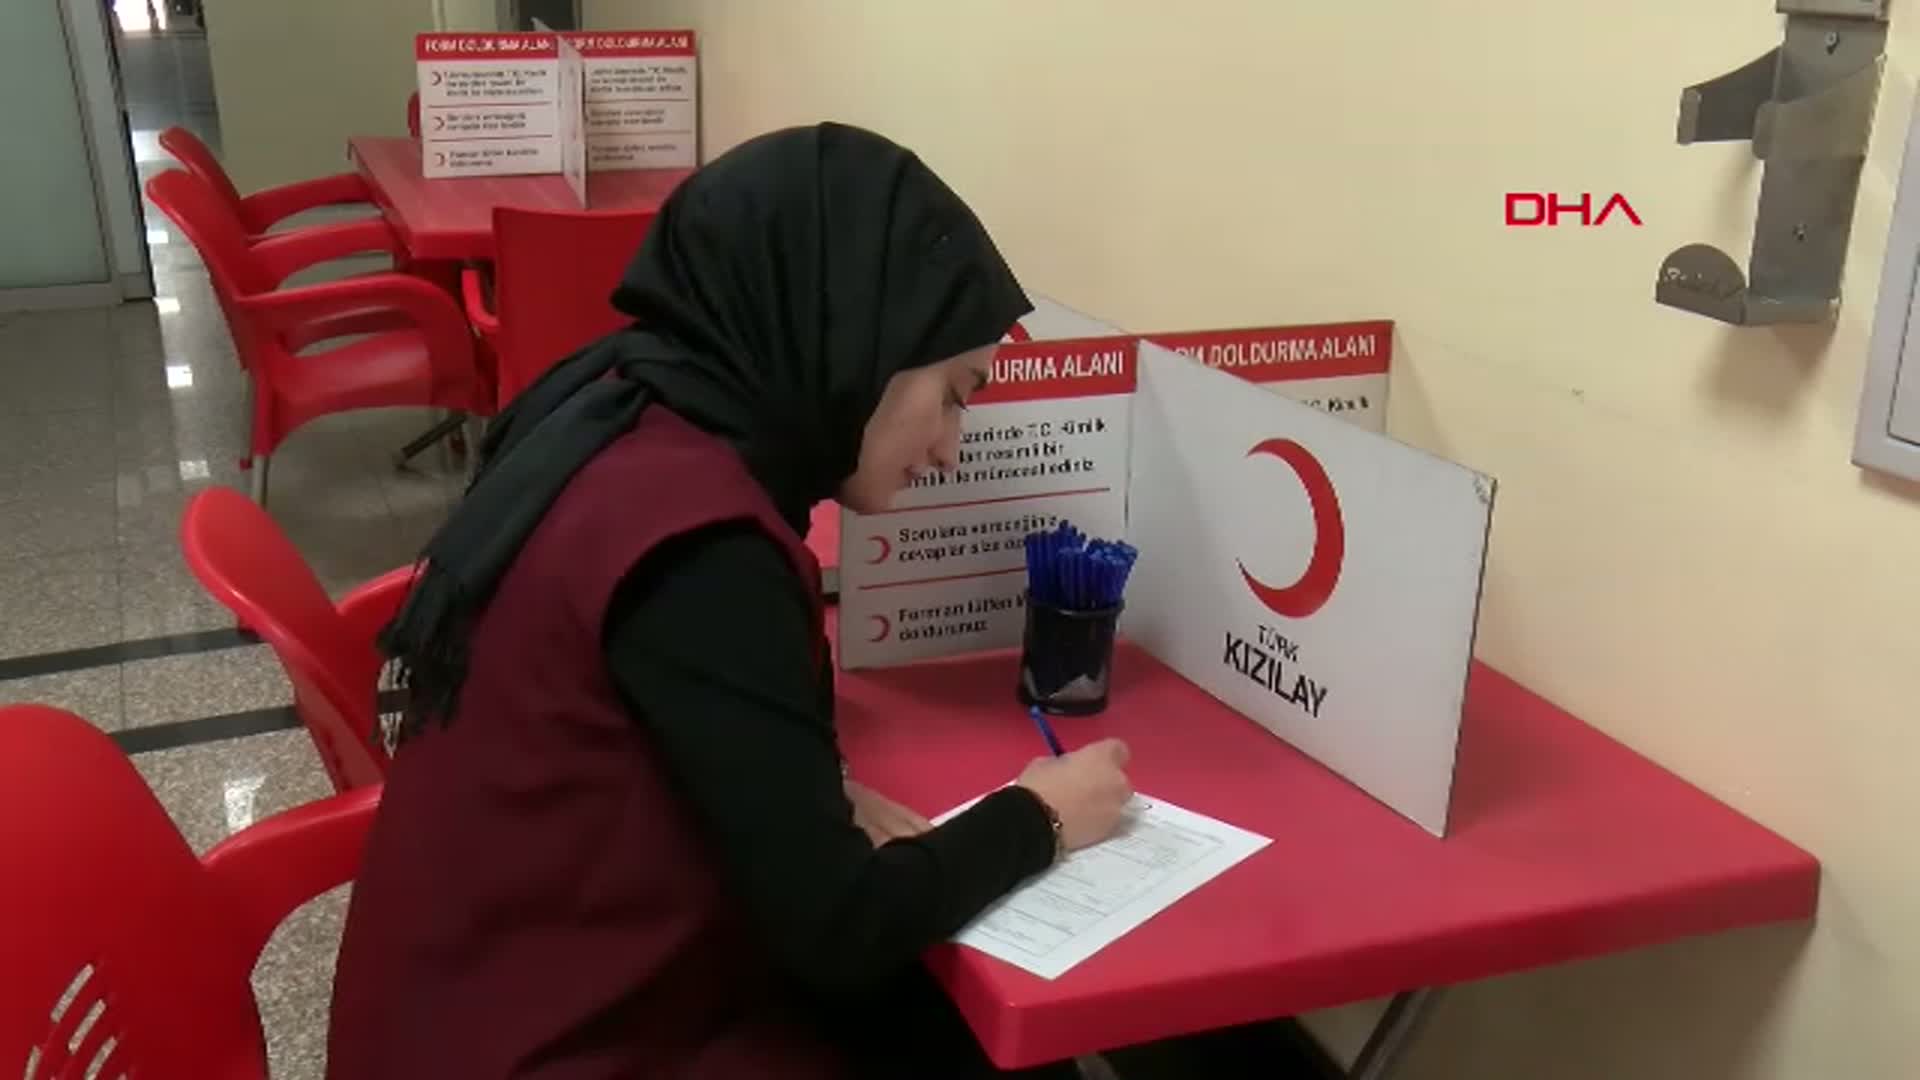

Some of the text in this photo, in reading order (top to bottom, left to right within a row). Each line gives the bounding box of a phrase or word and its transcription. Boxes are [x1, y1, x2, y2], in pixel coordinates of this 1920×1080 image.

[1061, 350, 1124, 379] ALANI
[1209, 338, 1318, 369] DOLDURMA
[1319, 333, 1376, 360] ALANI
[1223, 630, 1328, 719] KIZILAY
